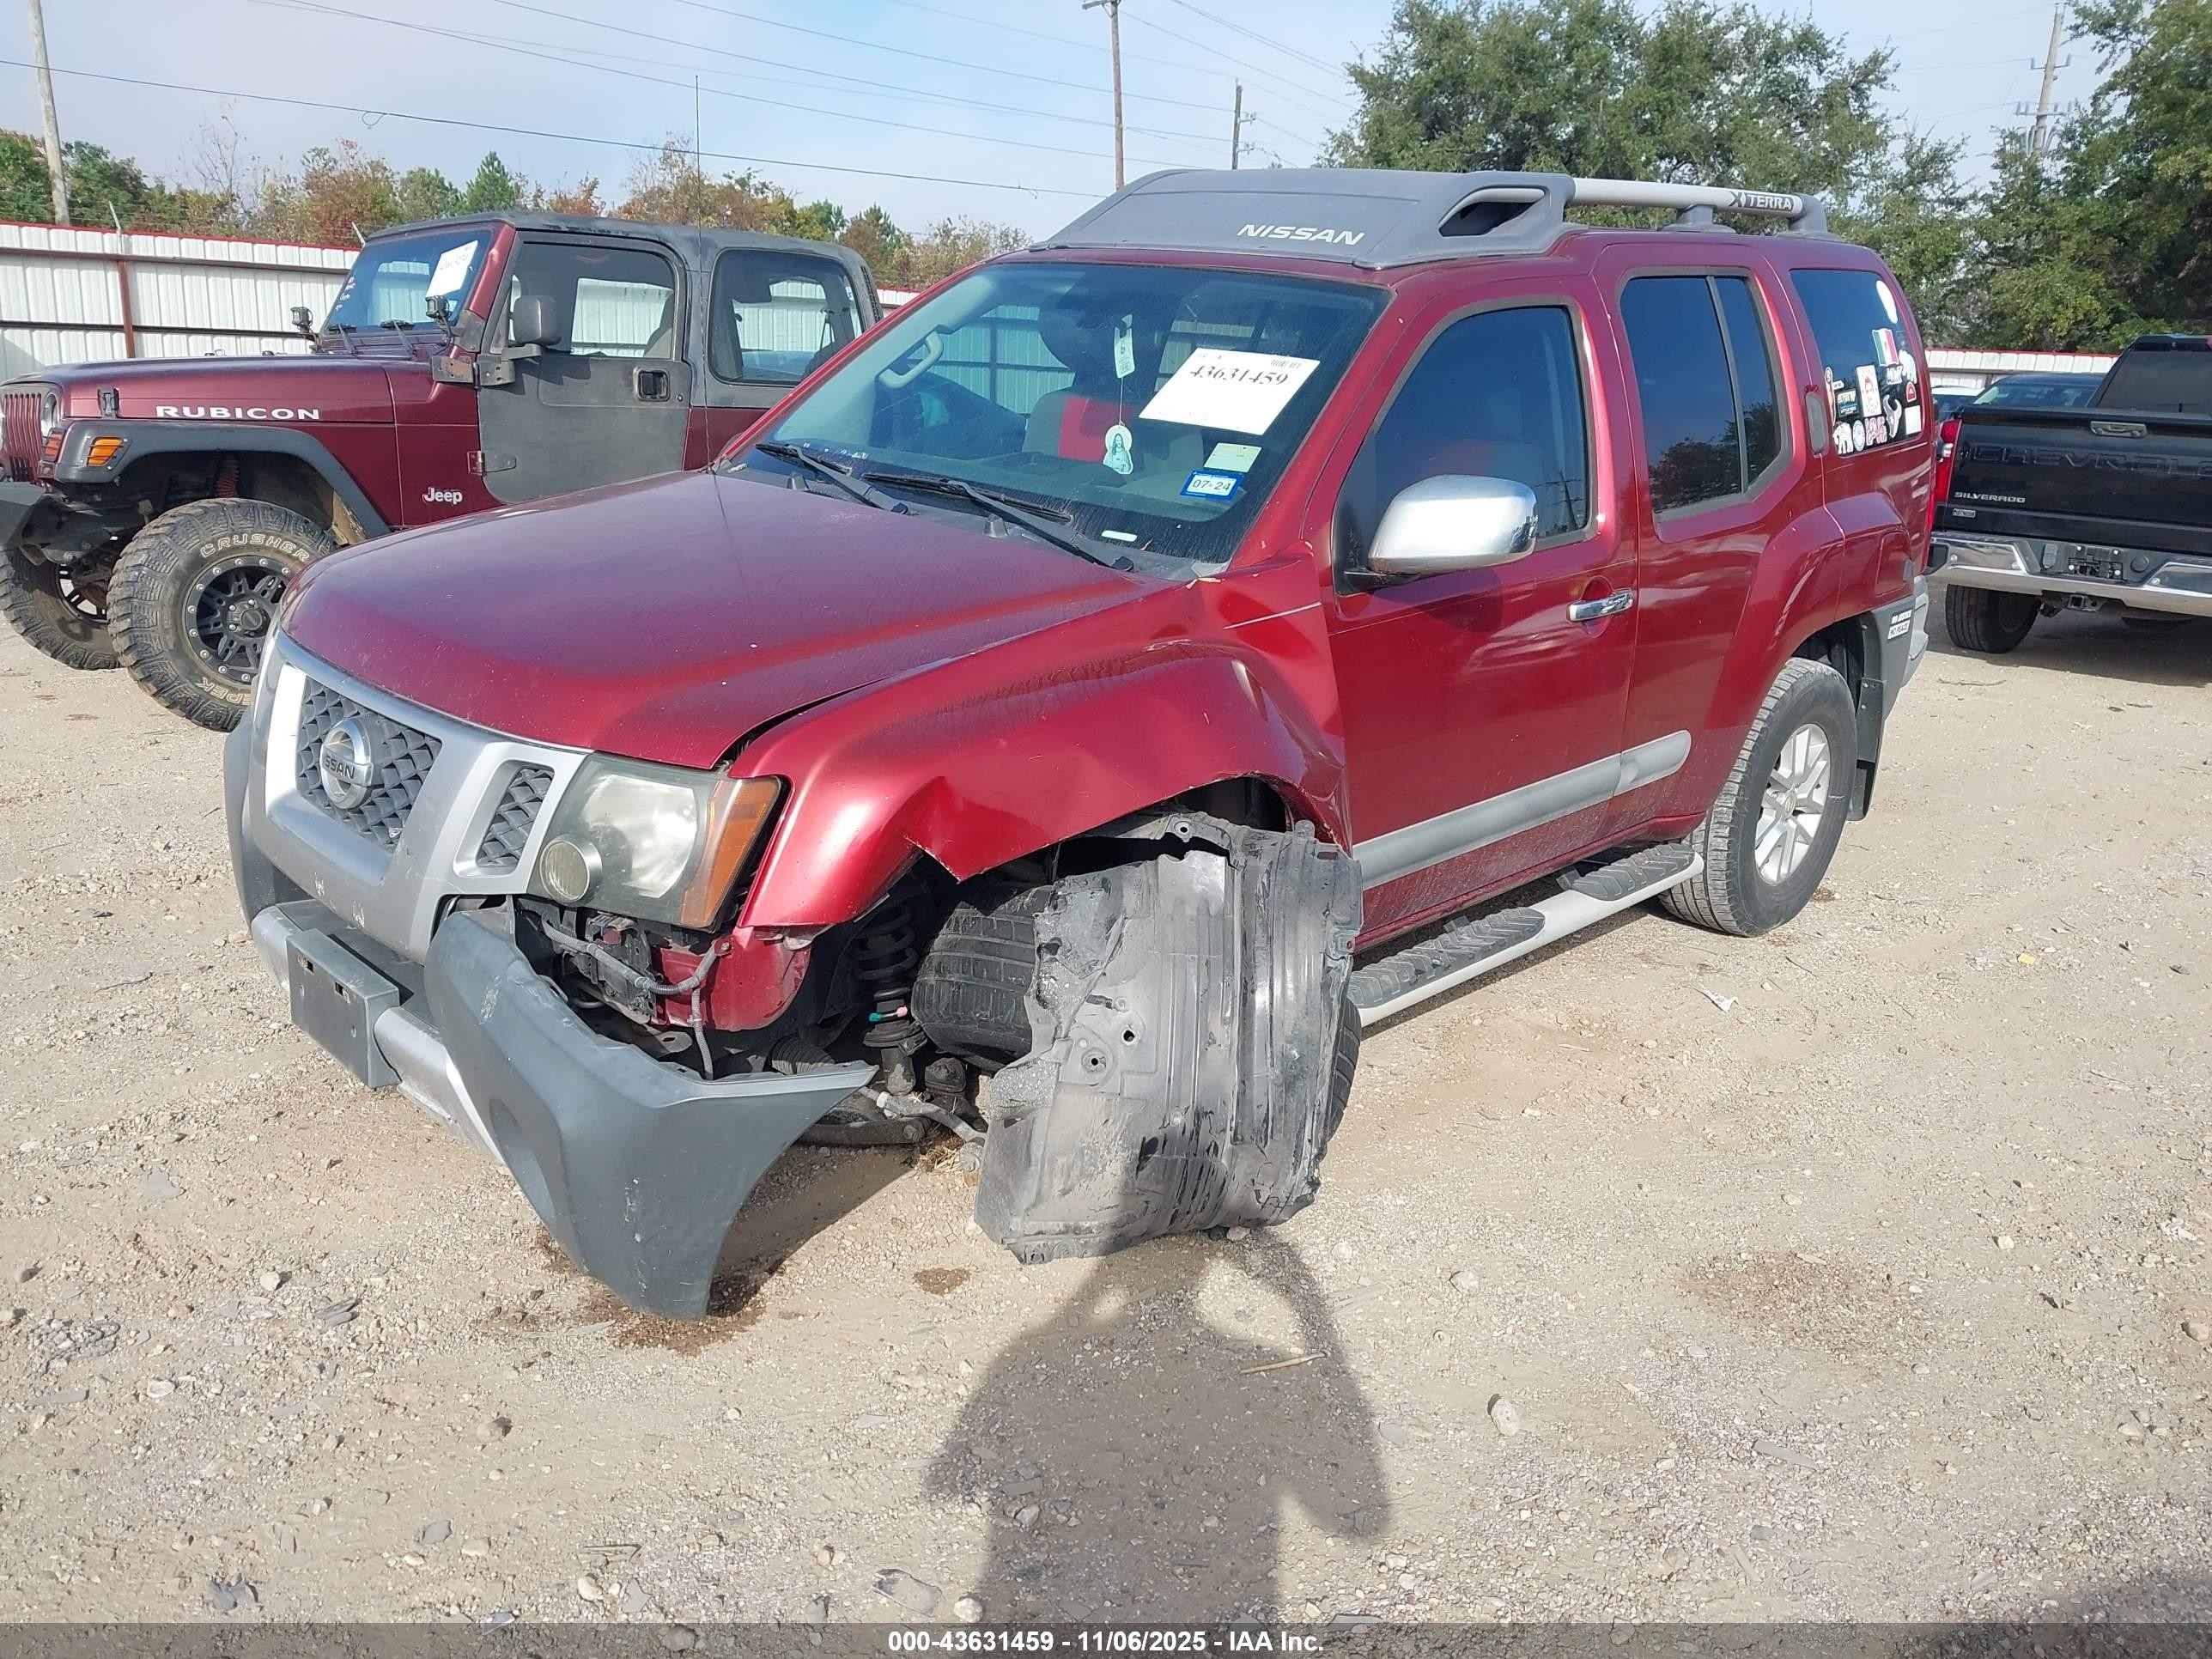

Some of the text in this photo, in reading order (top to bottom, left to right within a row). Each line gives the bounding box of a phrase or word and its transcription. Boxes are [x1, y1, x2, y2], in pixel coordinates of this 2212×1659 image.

[1729, 191, 1795, 212] XTERRA
[1237, 224, 1365, 246] NISSAN
[1190, 365, 1289, 386] 43631459
[155, 405, 319, 420] RUBICON
[422, 486, 463, 505] Jeep
[1954, 491, 2026, 503] SILVERADO
[199, 533, 310, 562] CRUSHER
[323, 753, 356, 780] ISSAN
